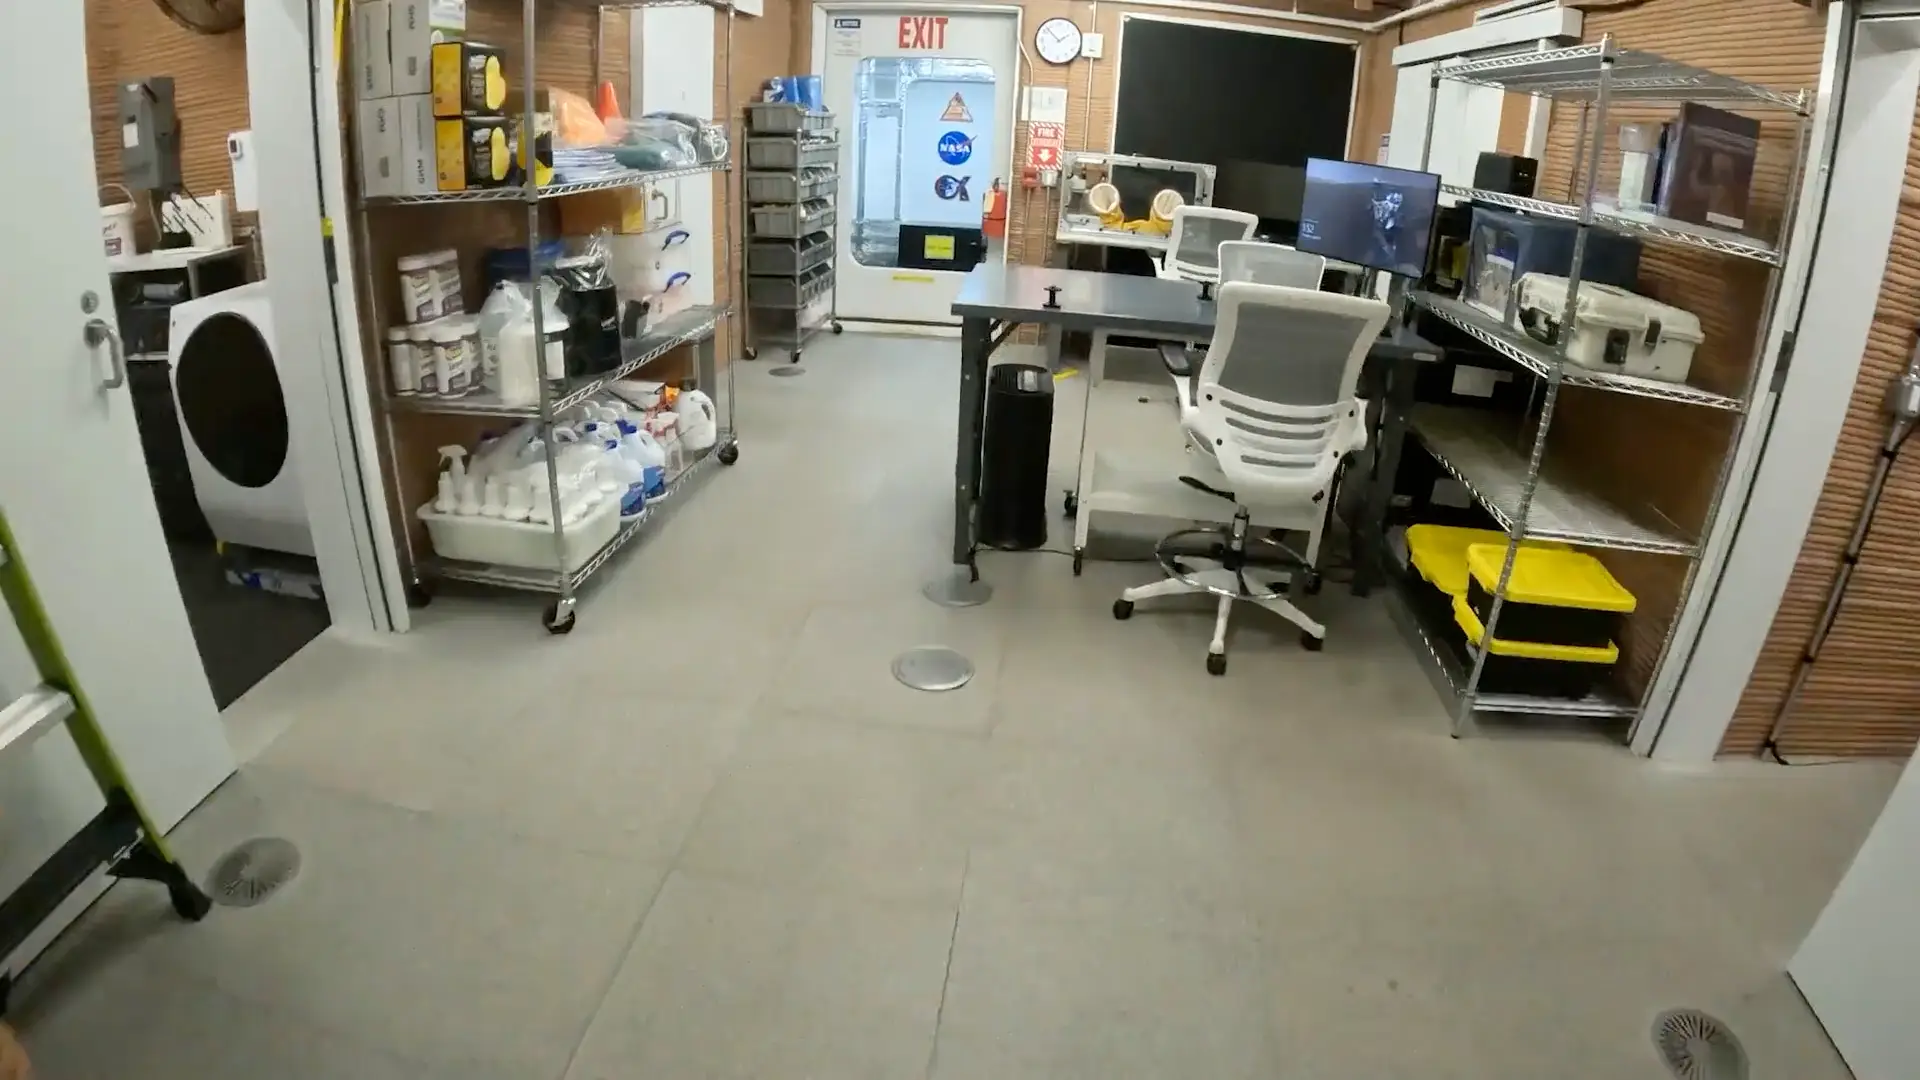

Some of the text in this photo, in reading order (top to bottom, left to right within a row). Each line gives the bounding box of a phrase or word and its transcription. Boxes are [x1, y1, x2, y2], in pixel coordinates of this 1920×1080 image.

[899, 16, 949, 50] EXIT
[1037, 127, 1057, 138] FIRE
[940, 143, 970, 152] NASA
